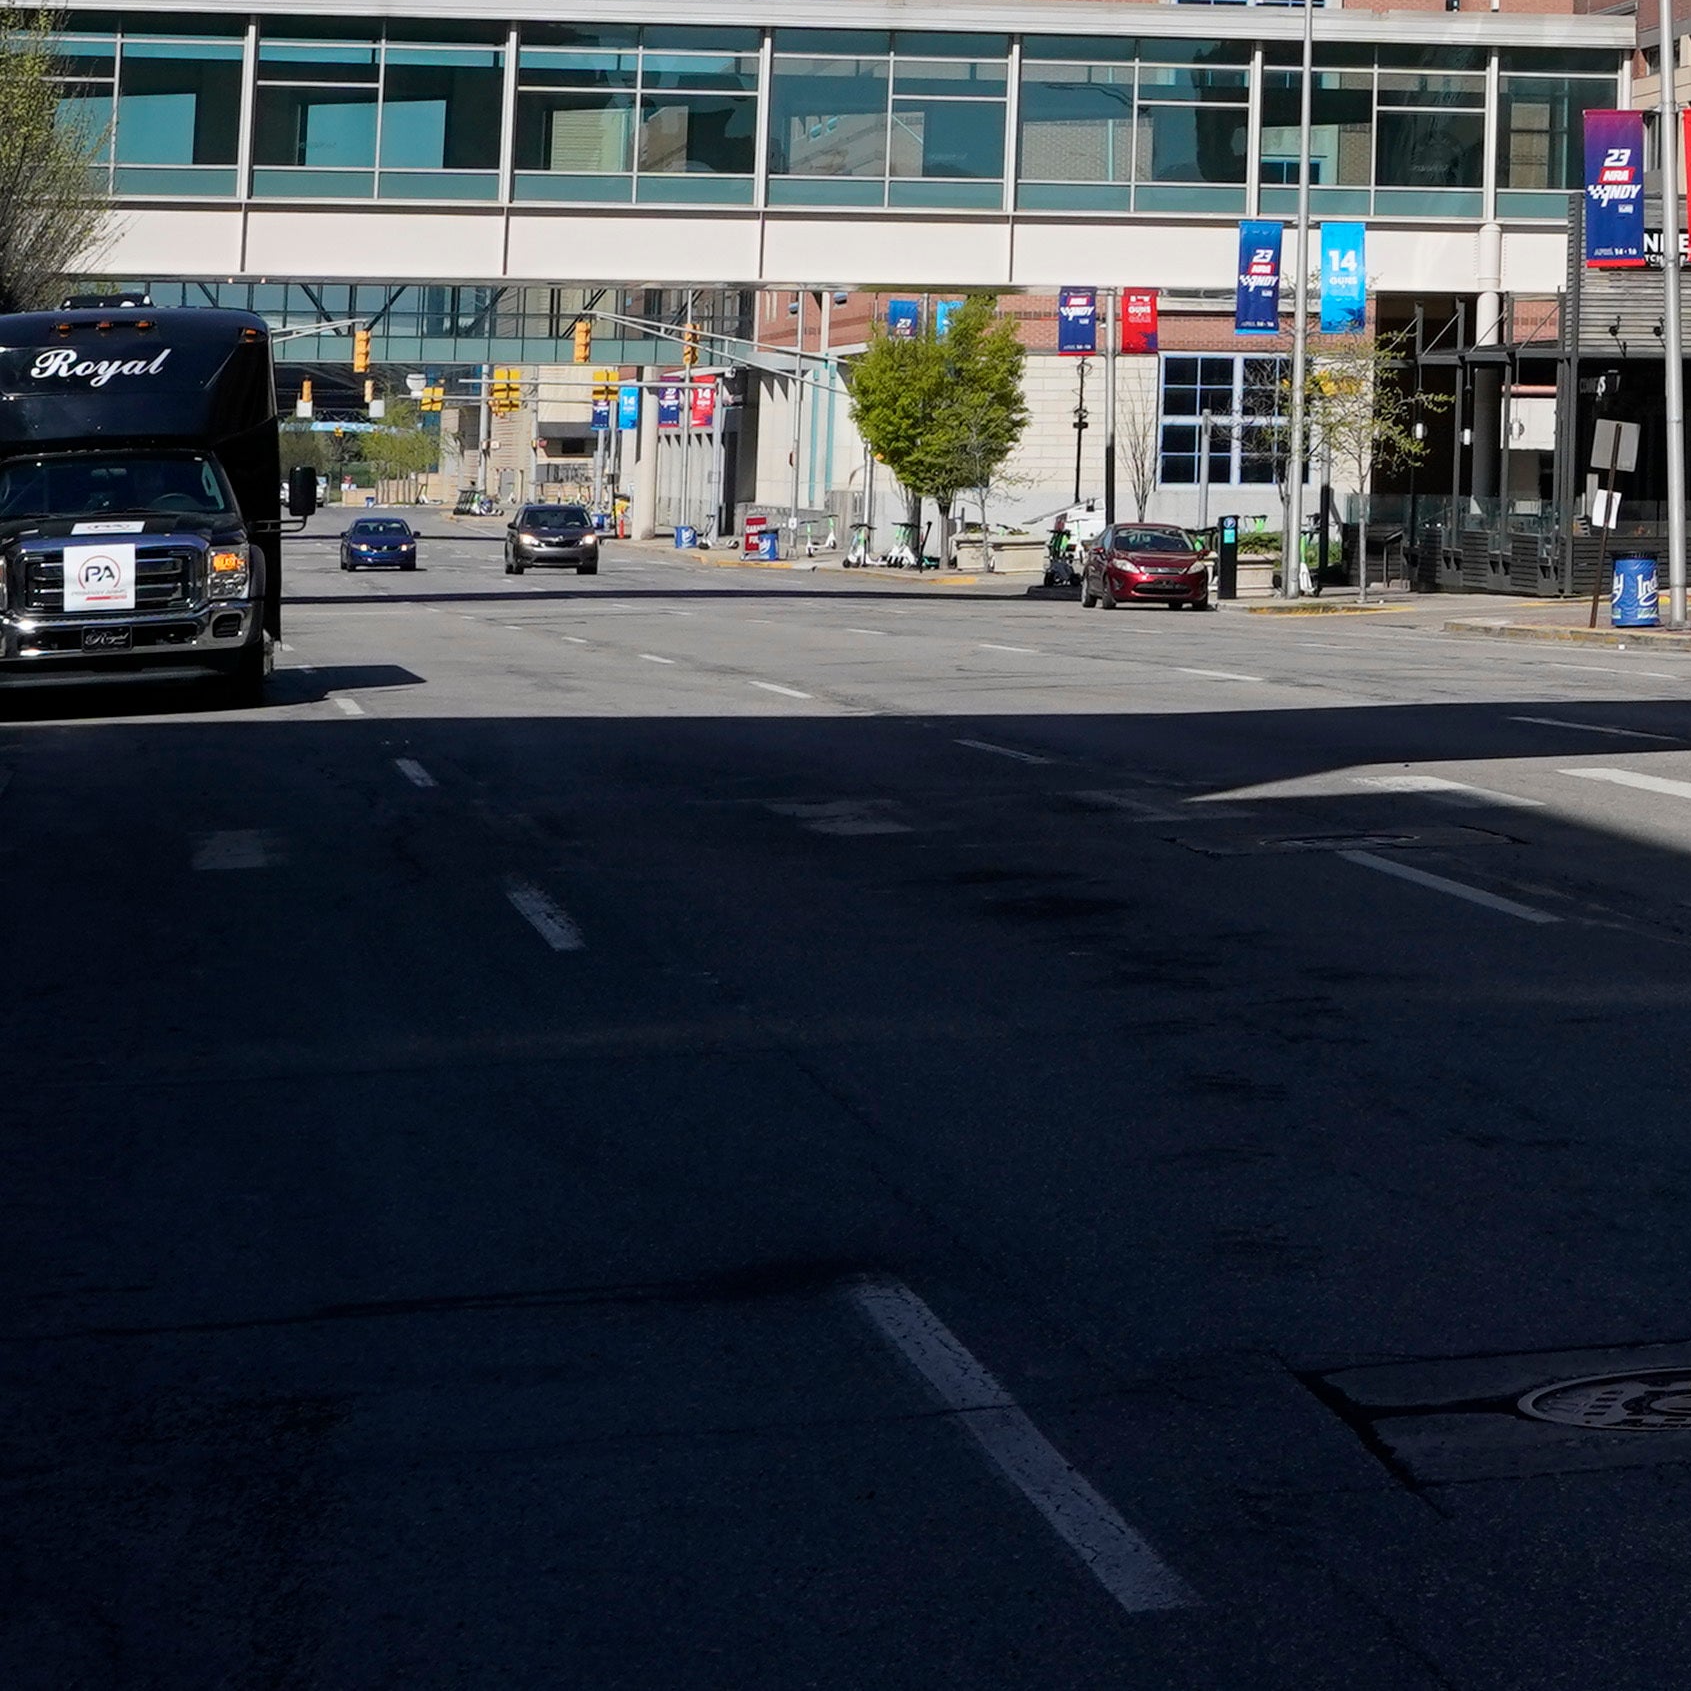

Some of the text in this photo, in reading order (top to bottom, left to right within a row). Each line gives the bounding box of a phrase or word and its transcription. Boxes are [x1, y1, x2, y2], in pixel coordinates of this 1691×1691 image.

[1604, 149, 1631, 166] 23
[1602, 170, 1629, 181] NRA
[1253, 249, 1274, 262] 23
[1329, 250, 1358, 272] 14
[30, 348, 172, 387] Royal
[84, 564, 115, 583] PA
